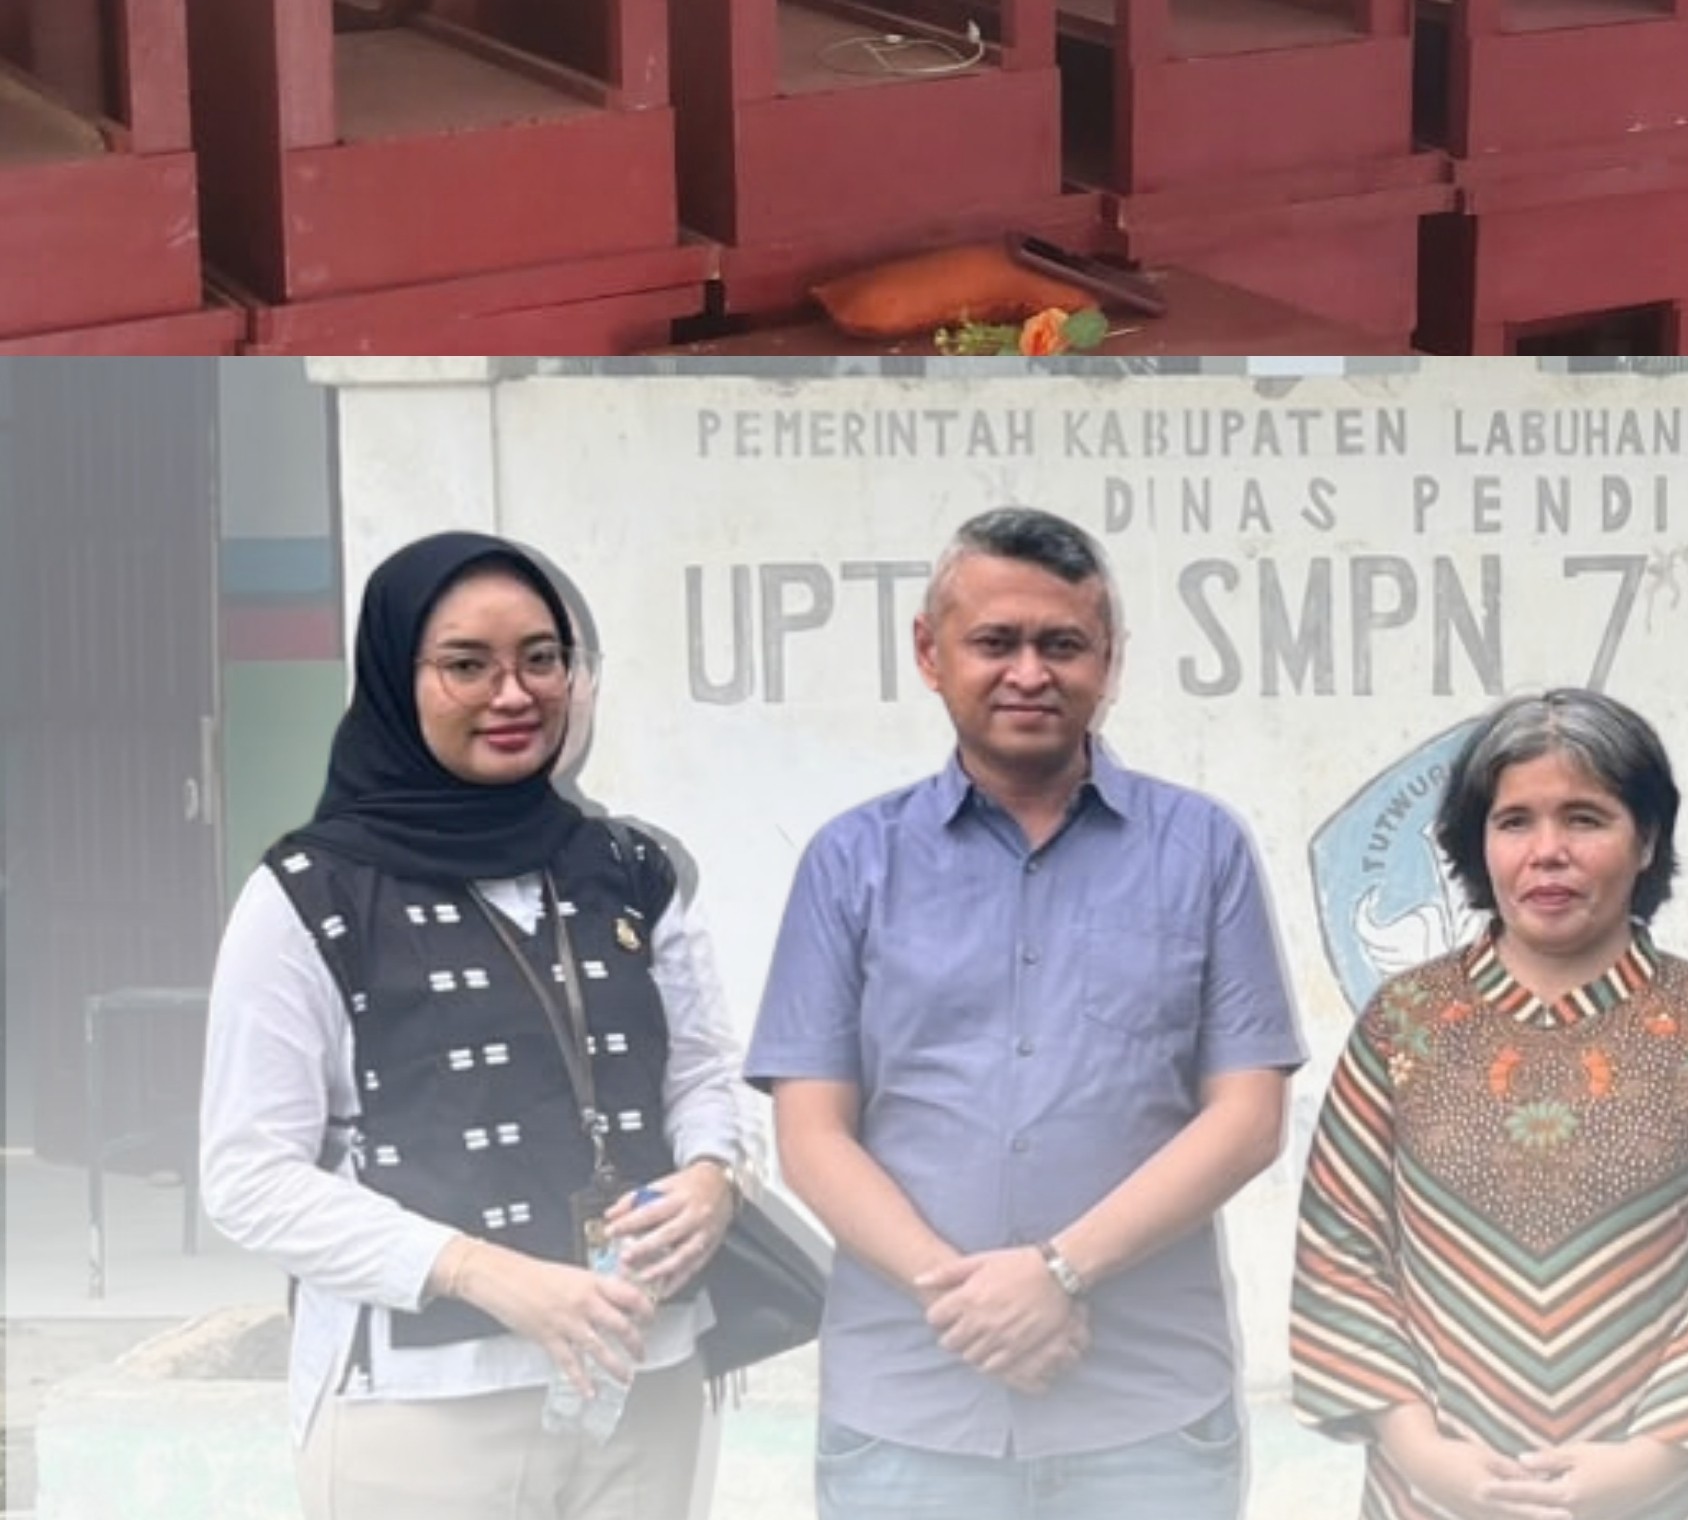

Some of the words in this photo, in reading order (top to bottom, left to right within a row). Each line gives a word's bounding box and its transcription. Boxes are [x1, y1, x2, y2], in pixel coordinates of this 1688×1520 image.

[698, 410, 1034, 457] PEMERINTAH
[1064, 408, 1406, 457] KABUPATEN
[1106, 477, 1337, 533] DINAS
[1178, 556, 1500, 697] SMPN
[1563, 555, 1648, 692] 7
